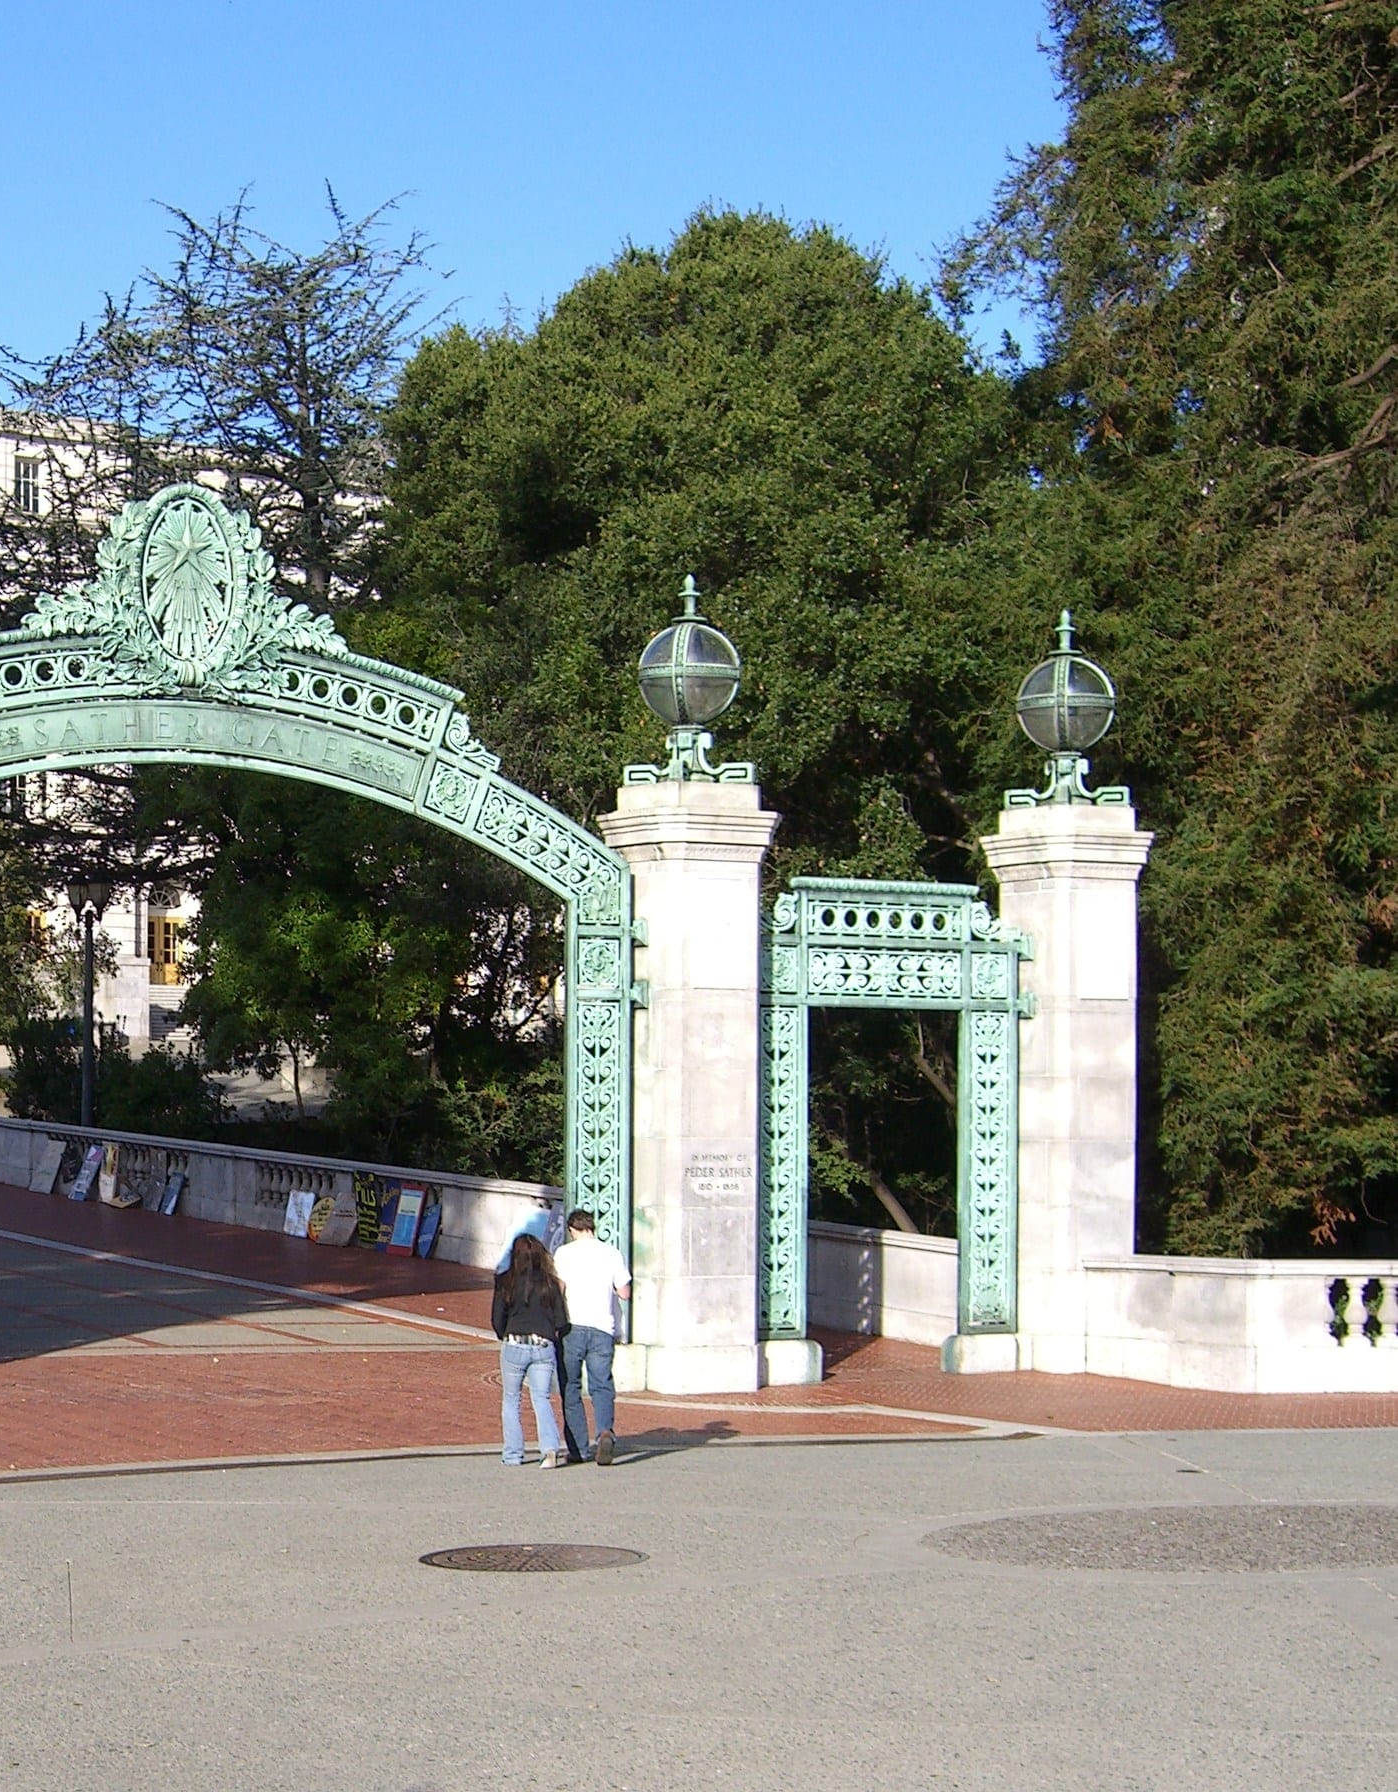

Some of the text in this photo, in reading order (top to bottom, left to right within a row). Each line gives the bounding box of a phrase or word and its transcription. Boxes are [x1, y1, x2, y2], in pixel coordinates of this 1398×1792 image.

[32, 708, 340, 764] SATHER GATE
[684, 1167, 752, 1178] PEDER SATHER
